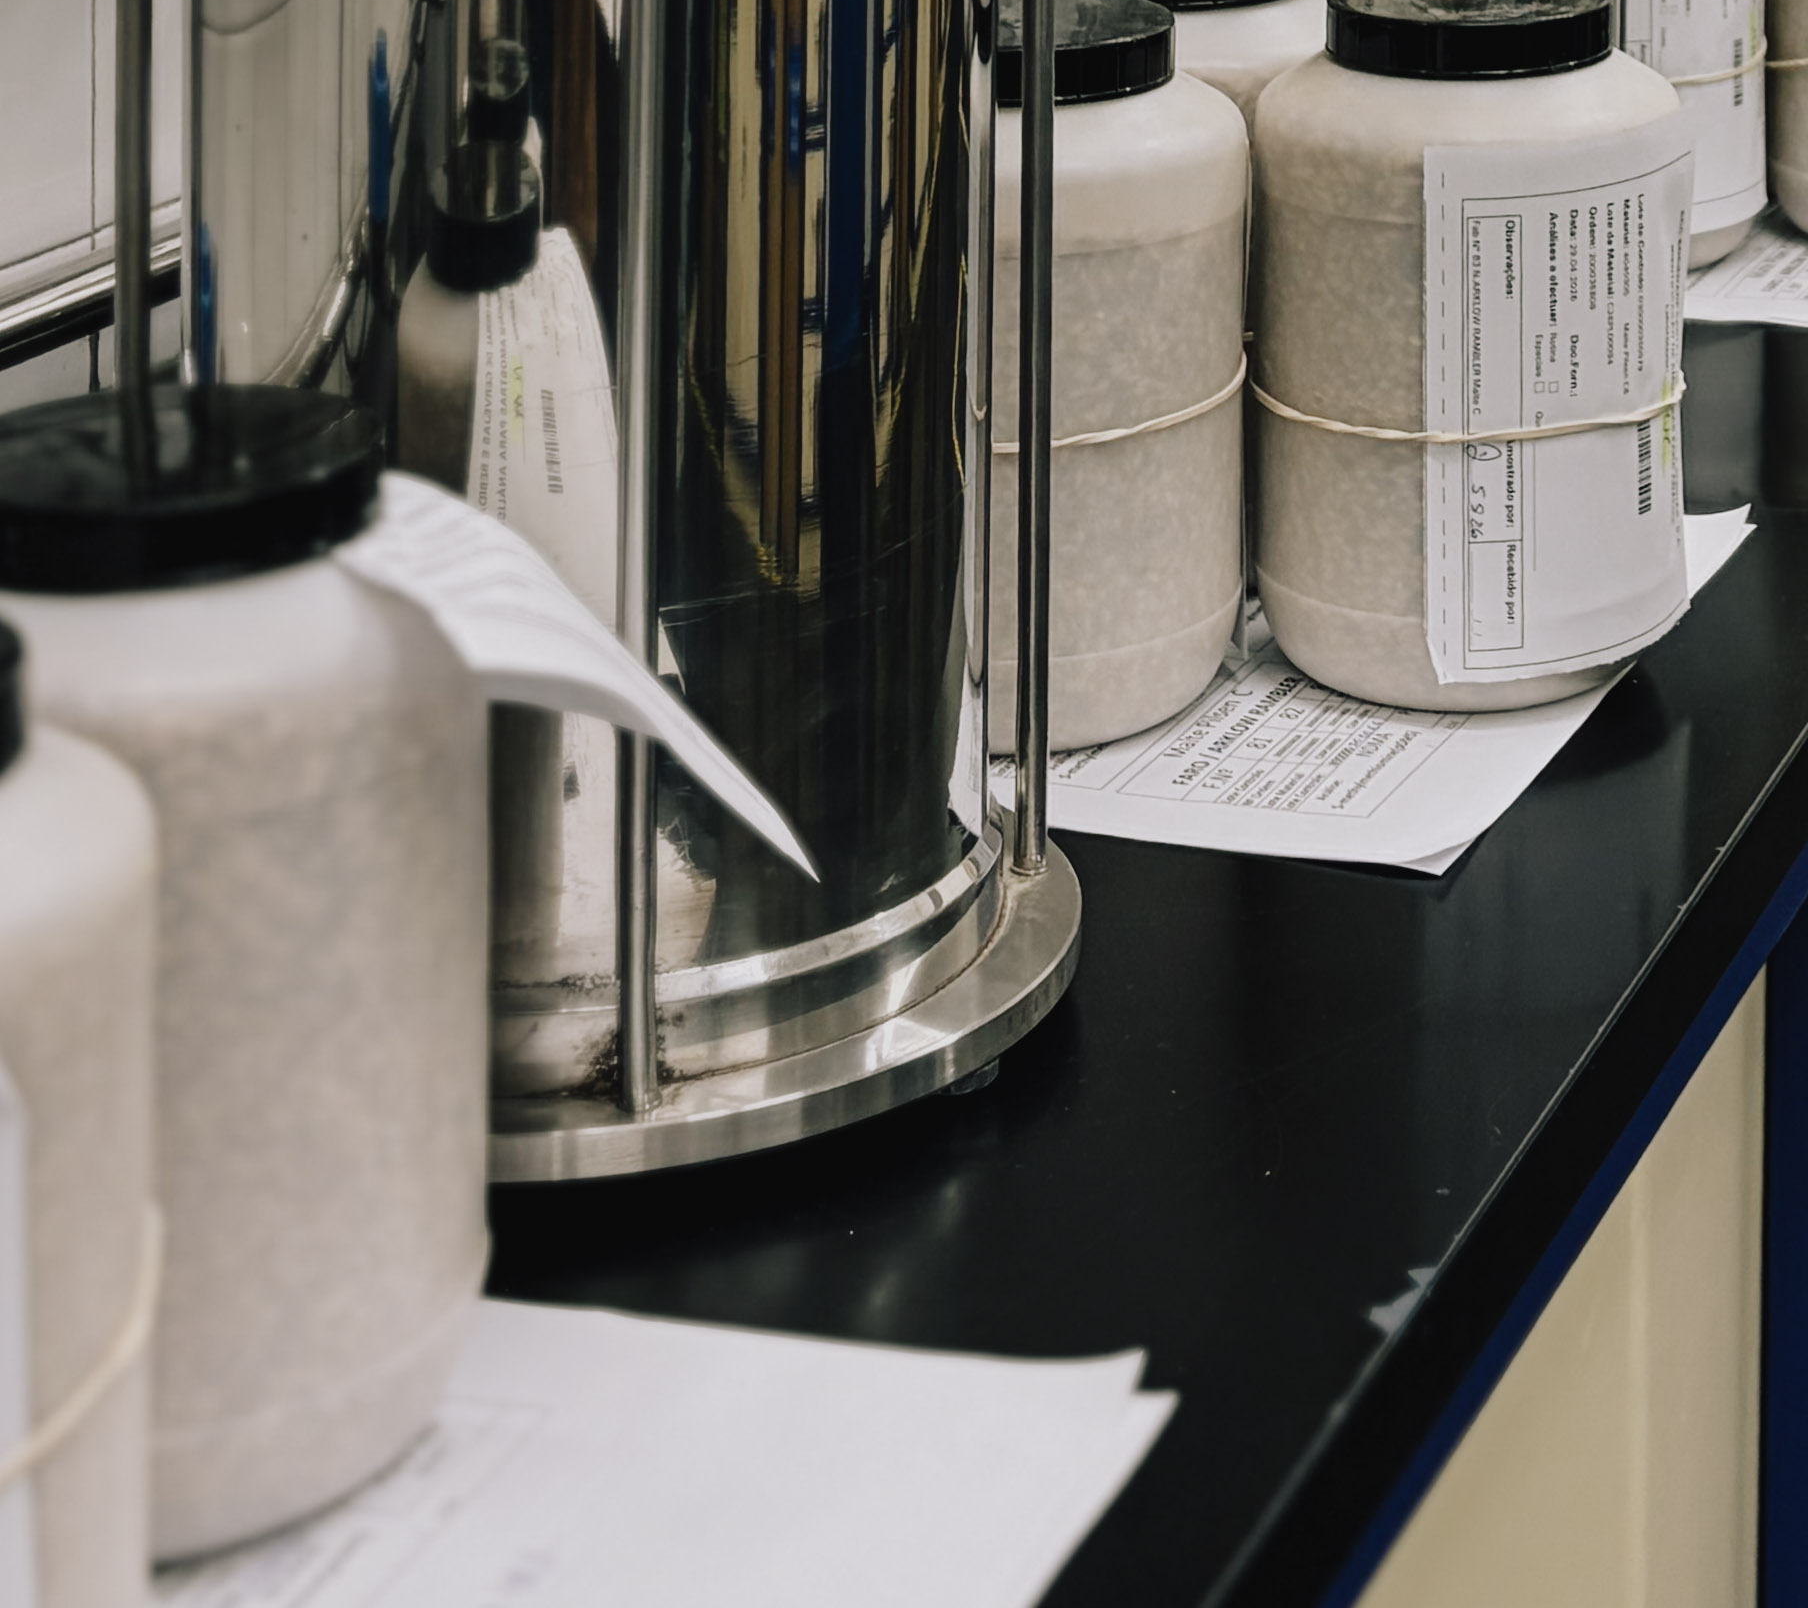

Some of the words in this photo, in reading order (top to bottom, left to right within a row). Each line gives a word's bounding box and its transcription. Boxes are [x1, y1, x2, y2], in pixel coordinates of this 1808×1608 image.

[1548, 212, 1560, 261] Análises
[1570, 209, 1578, 240] Data:
[1502, 220, 1516, 299] Observações:
[1472, 328, 1482, 376] RAMBLER
[1506, 545, 1517, 597] Recebido
[1172, 760, 1210, 786] FARO
[1207, 714, 1259, 755] ARKLOW
